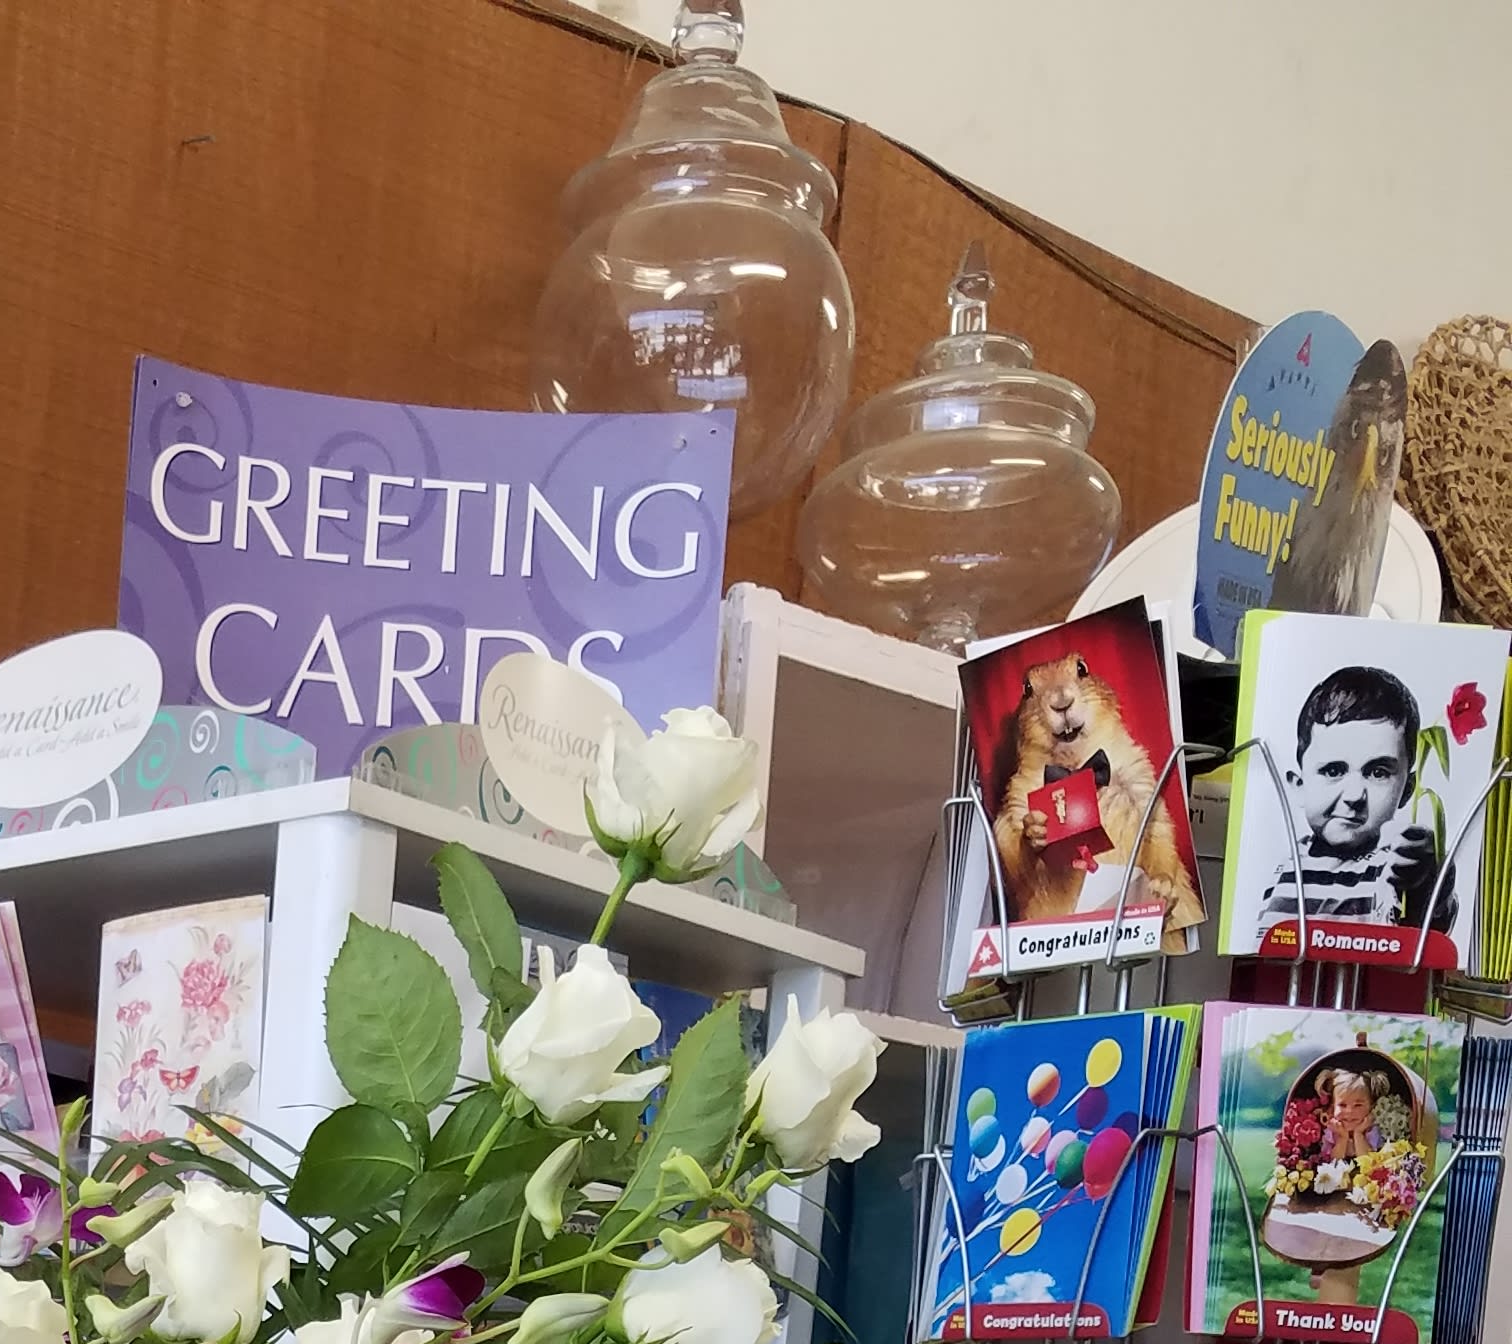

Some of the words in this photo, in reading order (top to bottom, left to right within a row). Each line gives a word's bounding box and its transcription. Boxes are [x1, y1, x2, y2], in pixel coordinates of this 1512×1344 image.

[1227, 395, 1336, 507] Seriously
[149, 441, 704, 580] GREETING
[1214, 473, 1300, 574] Funny!
[488, 684, 600, 763] Renaissan
[1019, 924, 1141, 958] Congratulatons
[1311, 929, 1401, 953] Romance
[983, 1313, 1102, 1330] Congratulatons
[1276, 1309, 1336, 1330] Thank
[1341, 1314, 1376, 1333] You
